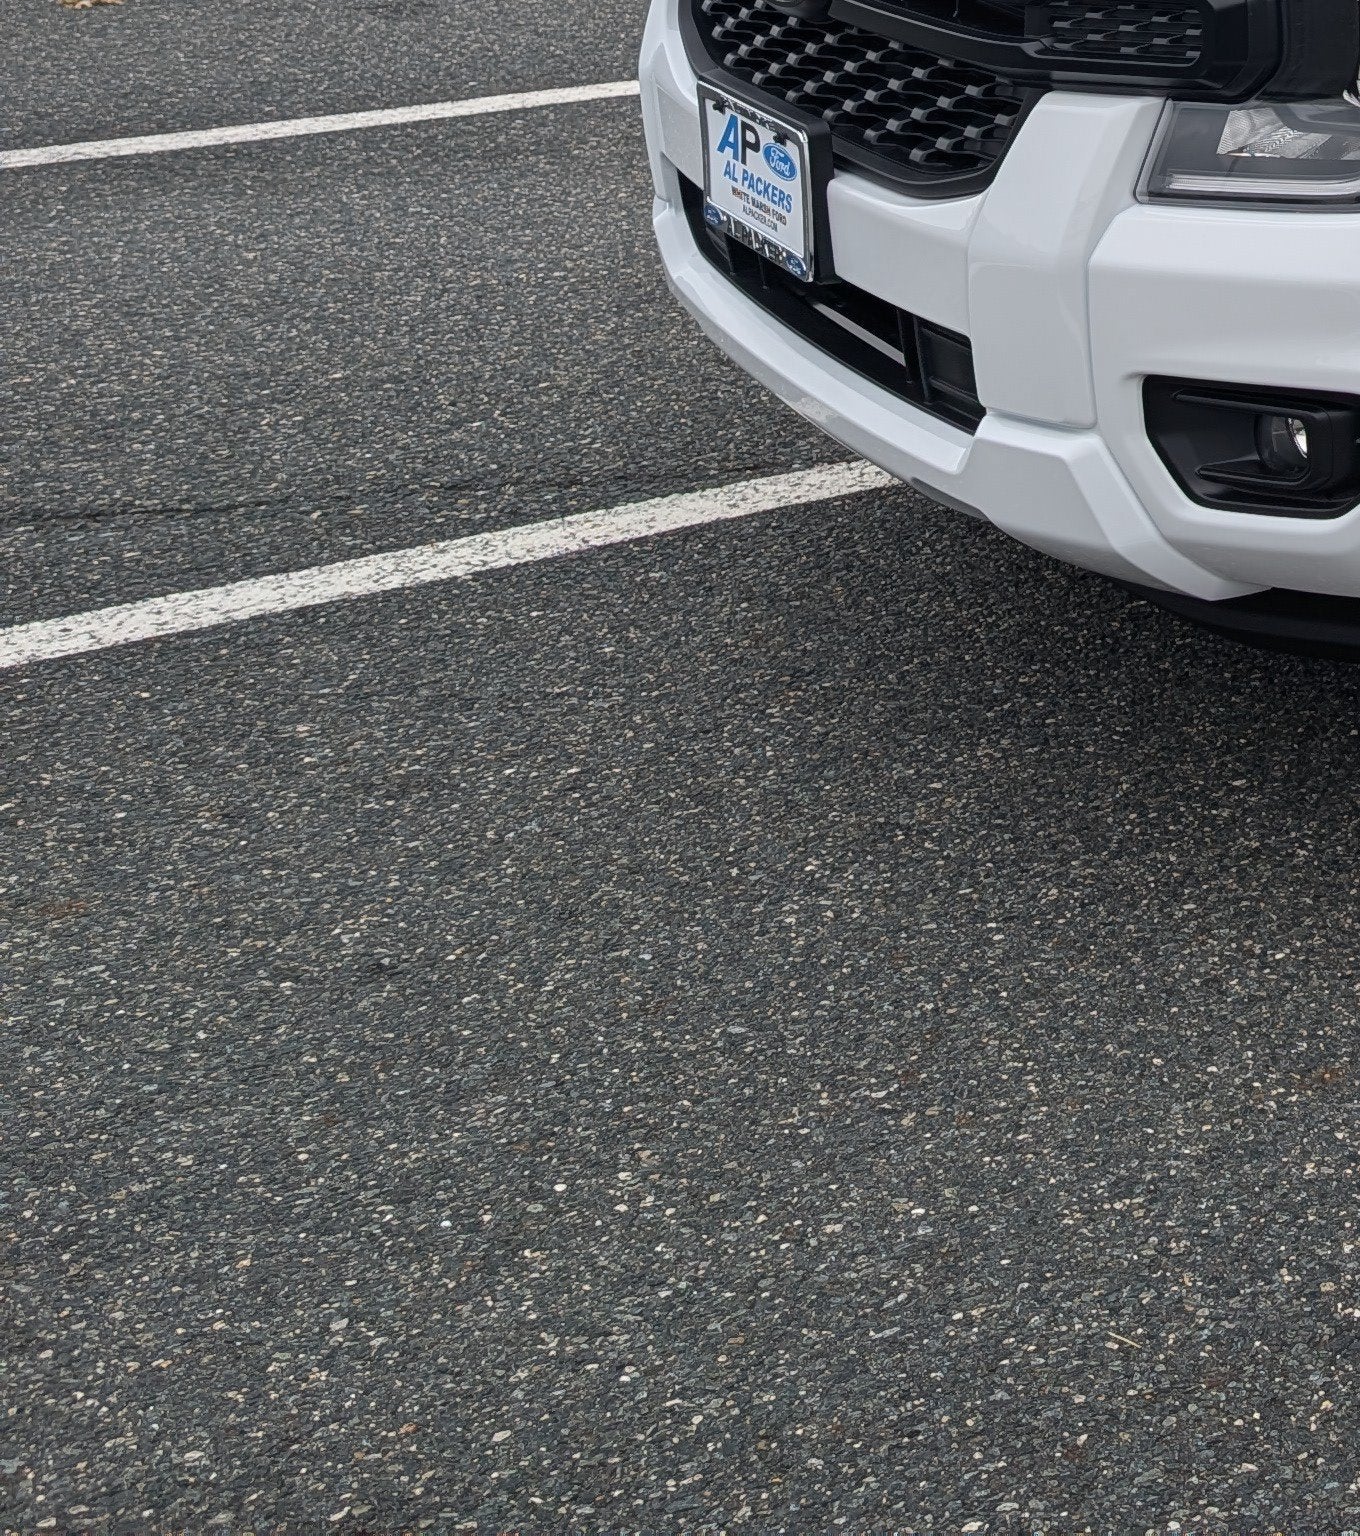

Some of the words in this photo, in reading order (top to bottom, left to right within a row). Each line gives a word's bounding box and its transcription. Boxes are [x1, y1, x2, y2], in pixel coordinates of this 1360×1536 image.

[717, 113, 761, 166] AP
[769, 147, 791, 177] Ford
[723, 160, 739, 184] AL
[742, 169, 793, 214] PACKERS
[731, 185, 750, 205] WHITE
[750, 194, 772, 216] MARSH
[771, 206, 788, 226] FORD
